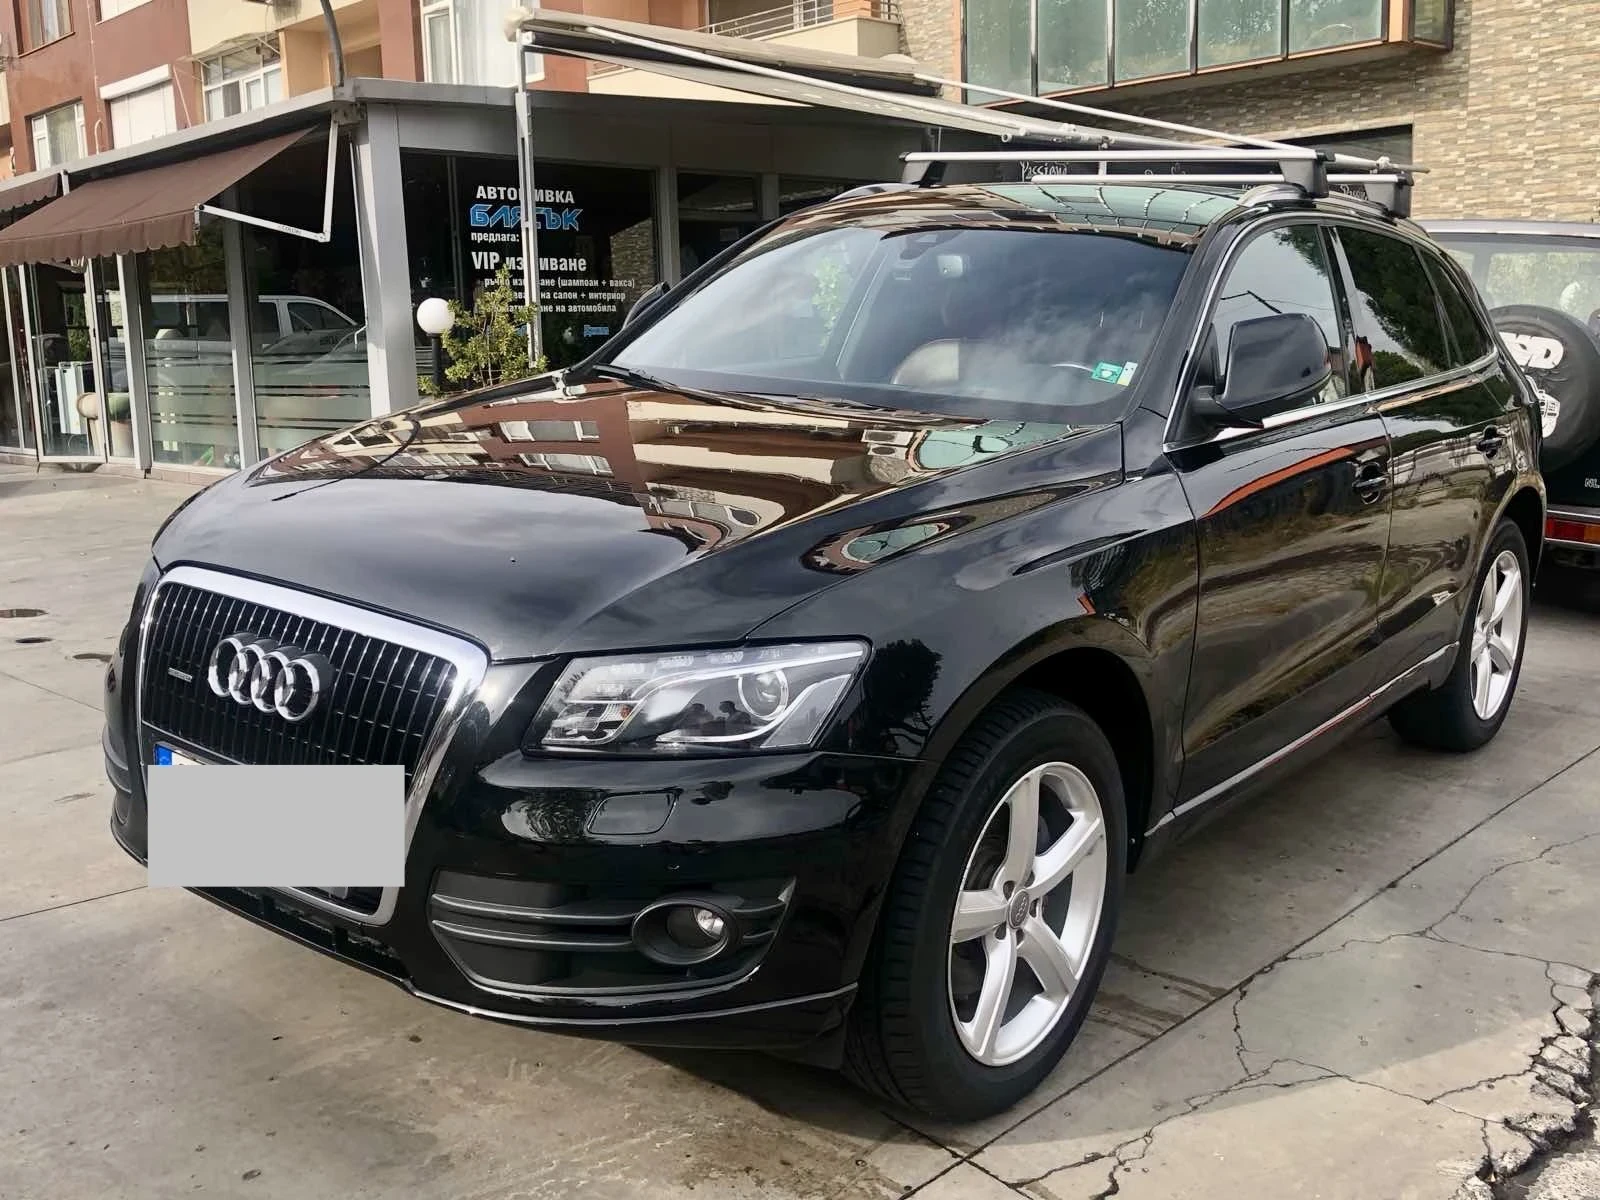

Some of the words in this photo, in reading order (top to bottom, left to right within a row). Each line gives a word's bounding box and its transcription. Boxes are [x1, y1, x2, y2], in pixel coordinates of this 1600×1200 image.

[476, 186, 575, 204] АВТОИВКА
[470, 232, 520, 243] предлага:
[471, 251, 500, 270] VIP
[505, 256, 587, 272] изиване
[553, 292, 578, 300] салон
[588, 292, 626, 302] интериор
[567, 303, 617, 312] автомобила
